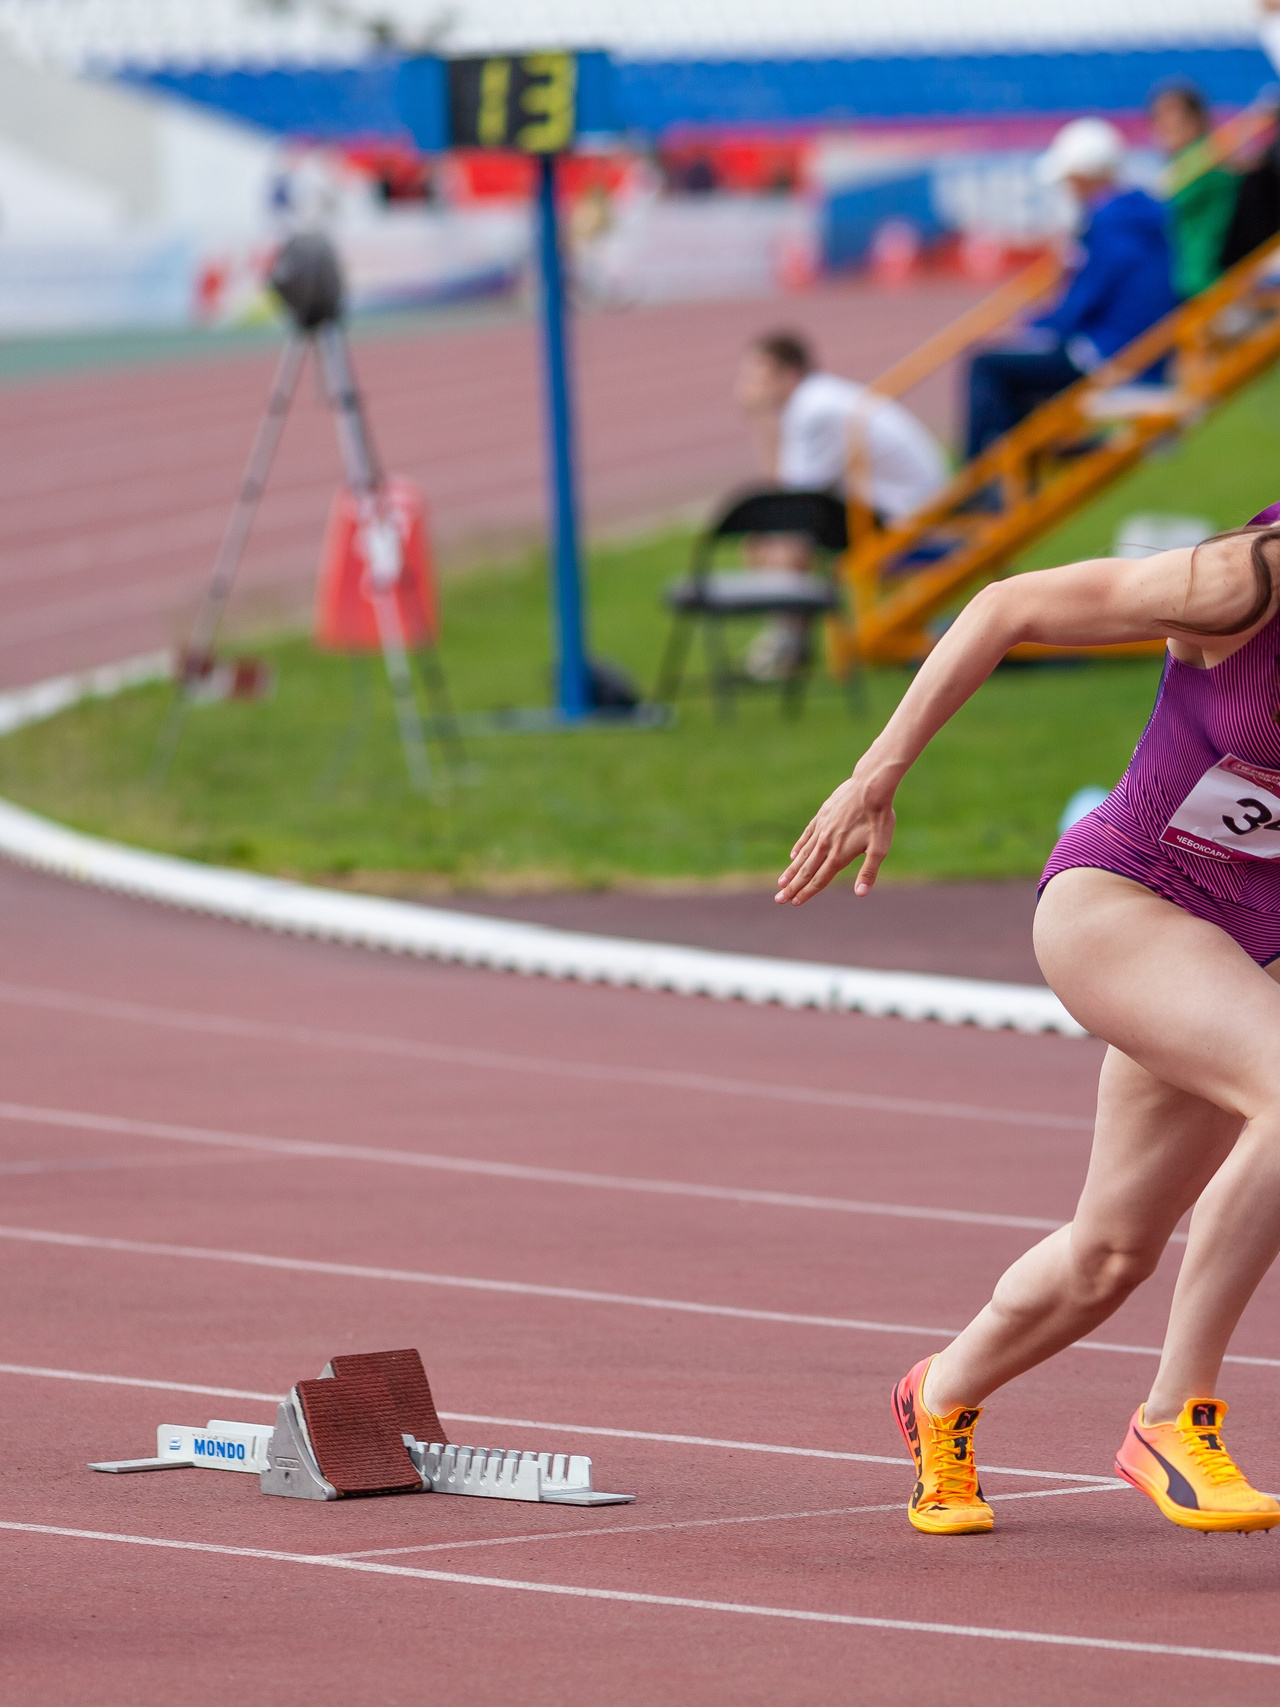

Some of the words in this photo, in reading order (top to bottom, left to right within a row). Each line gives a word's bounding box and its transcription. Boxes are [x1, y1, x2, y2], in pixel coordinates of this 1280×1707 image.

[478, 50, 575, 153] 13
[1176, 834, 1231, 860] ЧЕБОКСАРЫ
[194, 1438, 245, 1460] MONDO
